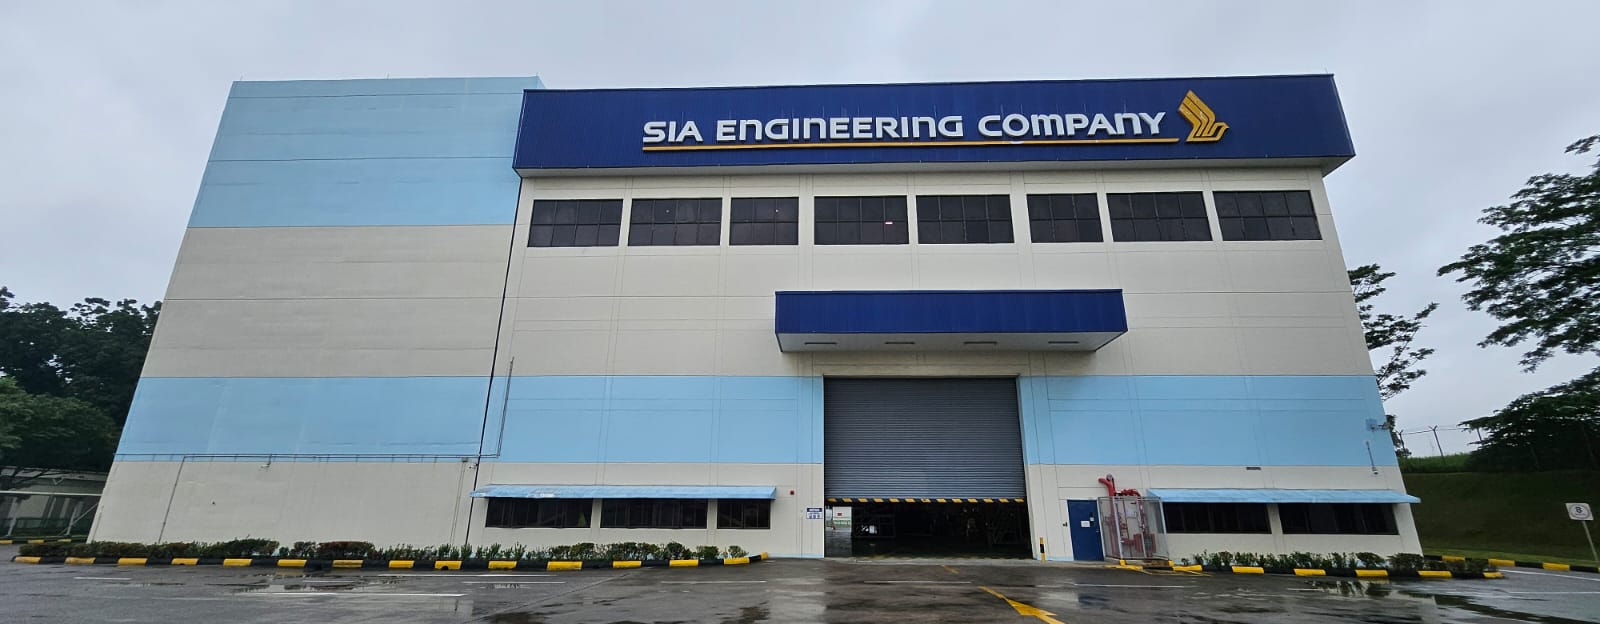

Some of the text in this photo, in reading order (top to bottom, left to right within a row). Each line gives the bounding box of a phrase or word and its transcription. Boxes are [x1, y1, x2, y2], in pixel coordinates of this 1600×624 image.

[643, 111, 1167, 143] SIA ENGINEERING COMPANY
